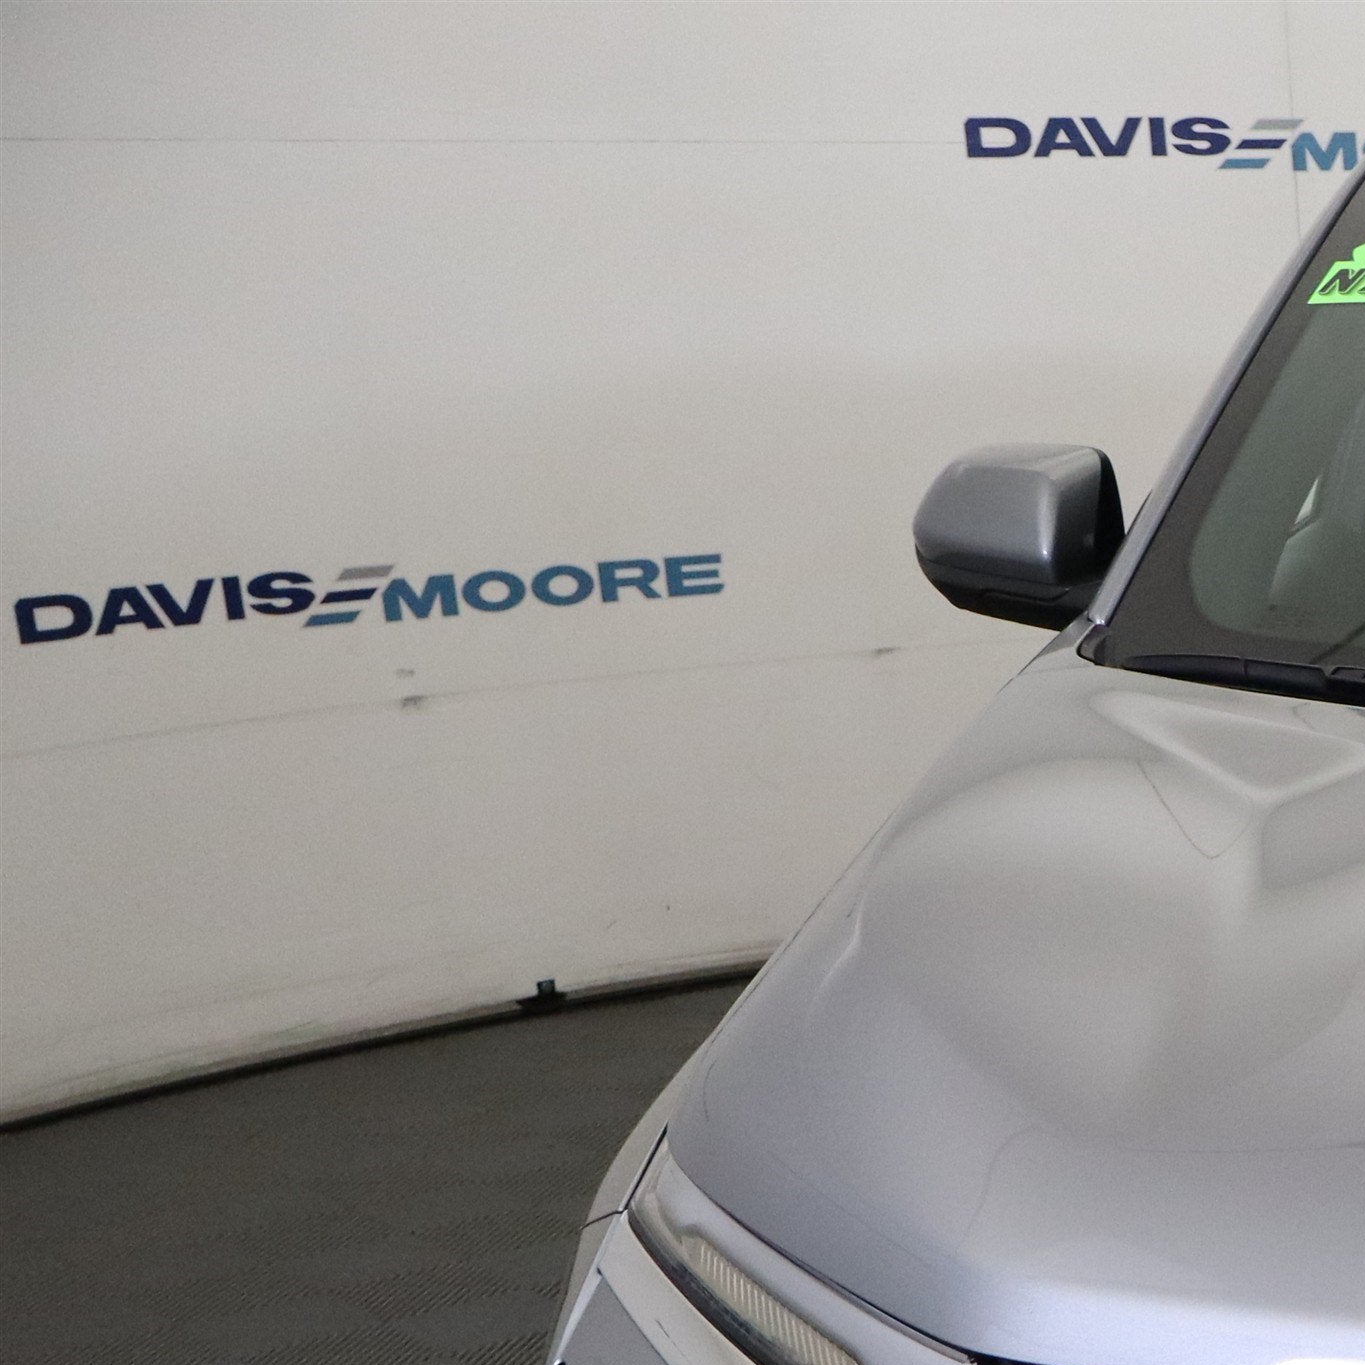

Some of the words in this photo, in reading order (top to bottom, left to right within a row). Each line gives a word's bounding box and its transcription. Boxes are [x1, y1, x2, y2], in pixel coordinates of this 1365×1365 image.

[963, 116, 1231, 159] DAVIS
[15, 570, 317, 645] DAVIS
[385, 553, 725, 623] MOORE
